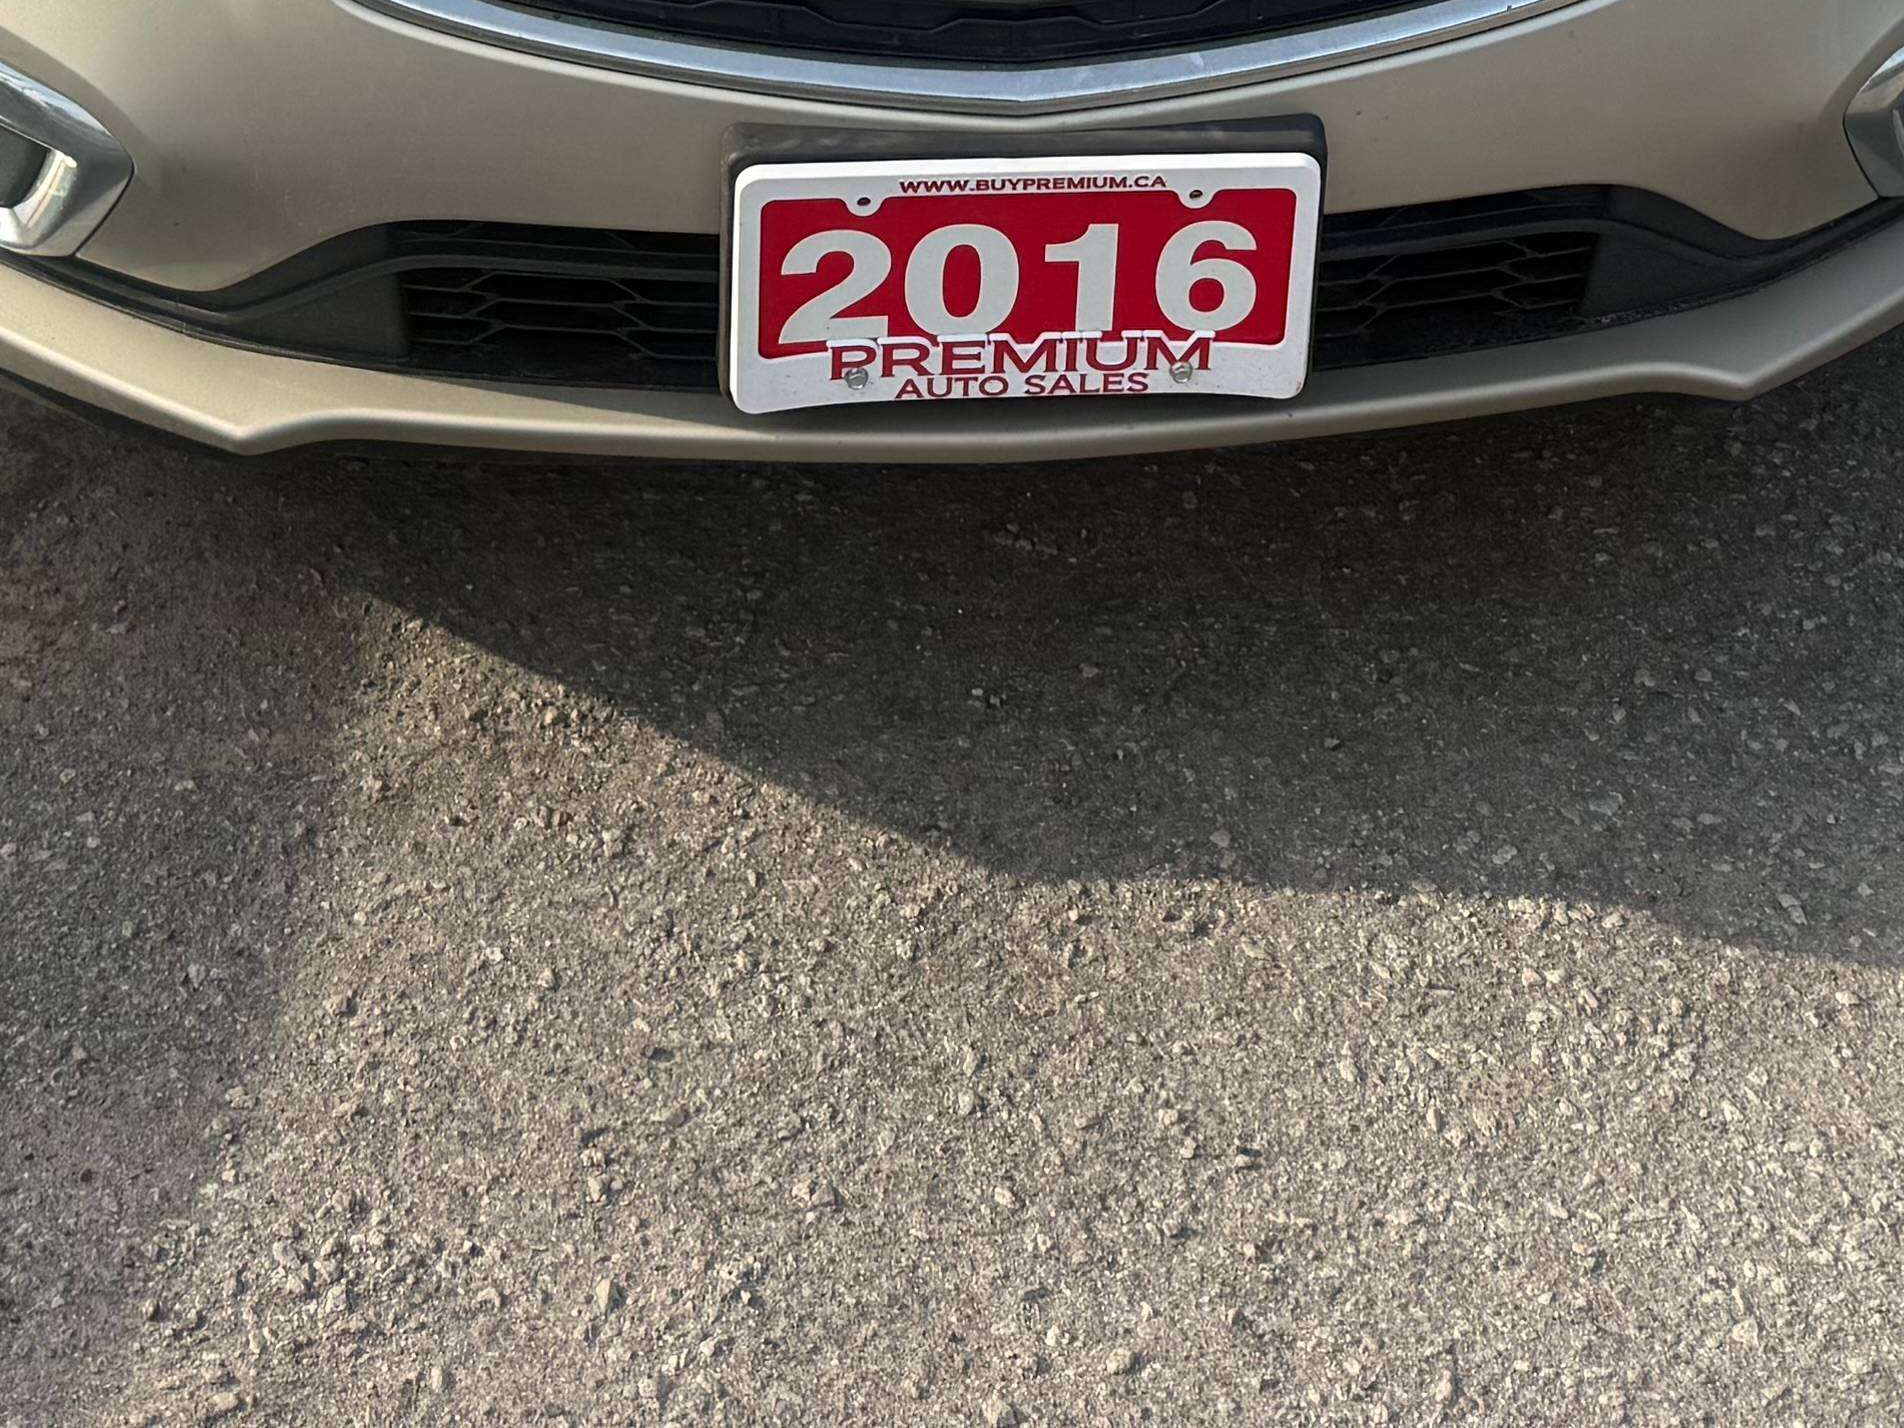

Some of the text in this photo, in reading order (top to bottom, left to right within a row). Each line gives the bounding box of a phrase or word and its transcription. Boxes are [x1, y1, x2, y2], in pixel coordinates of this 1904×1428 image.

[899, 175, 1167, 194] WWW.BUYPREMIUM.CA
[779, 220, 1257, 345] 2016
[827, 332, 1215, 382] PREMIUM
[895, 372, 1150, 400] AUTO SALES
